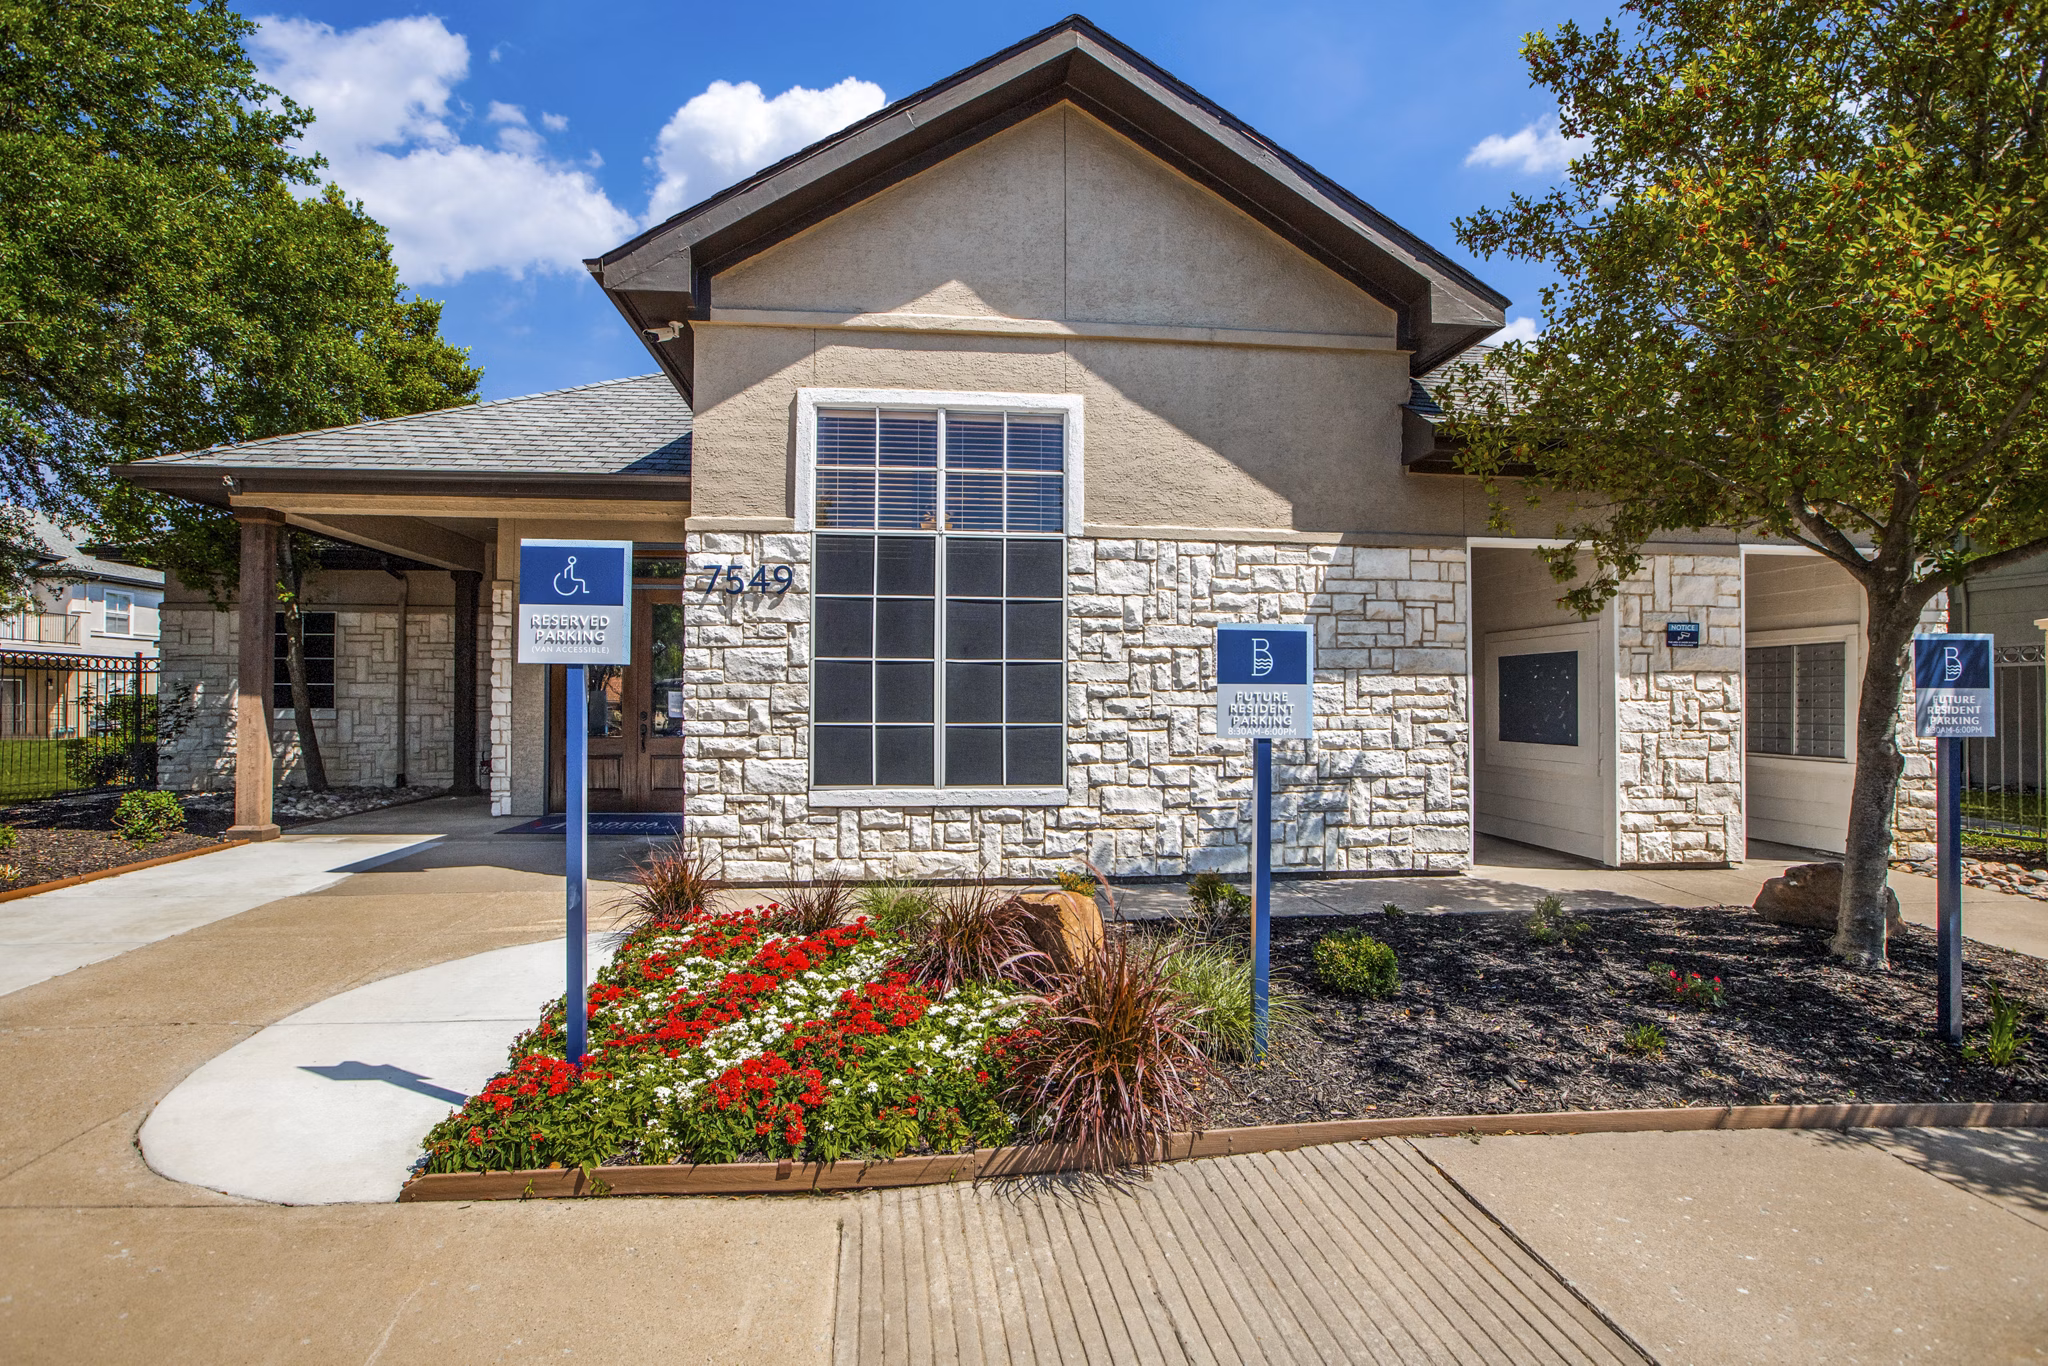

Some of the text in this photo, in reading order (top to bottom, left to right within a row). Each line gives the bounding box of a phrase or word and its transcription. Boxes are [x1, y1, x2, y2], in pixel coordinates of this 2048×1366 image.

[703, 565, 793, 595] 7549
[531, 614, 610, 628] RESERVED
[535, 630, 605, 643] PARKING
[555, 646, 610, 654] ACCESSIBLE)
[1236, 692, 1288, 702] FUTURE
[1932, 695, 1976, 704] FUTURE
[1229, 704, 1295, 715] RESIDENT
[1927, 705, 1982, 715] RESIDENT
[1232, 716, 1292, 727] PARKING
[1930, 716, 1980, 725] PARKING
[1227, 727, 1297, 736] 8:30AM-6:00PM
